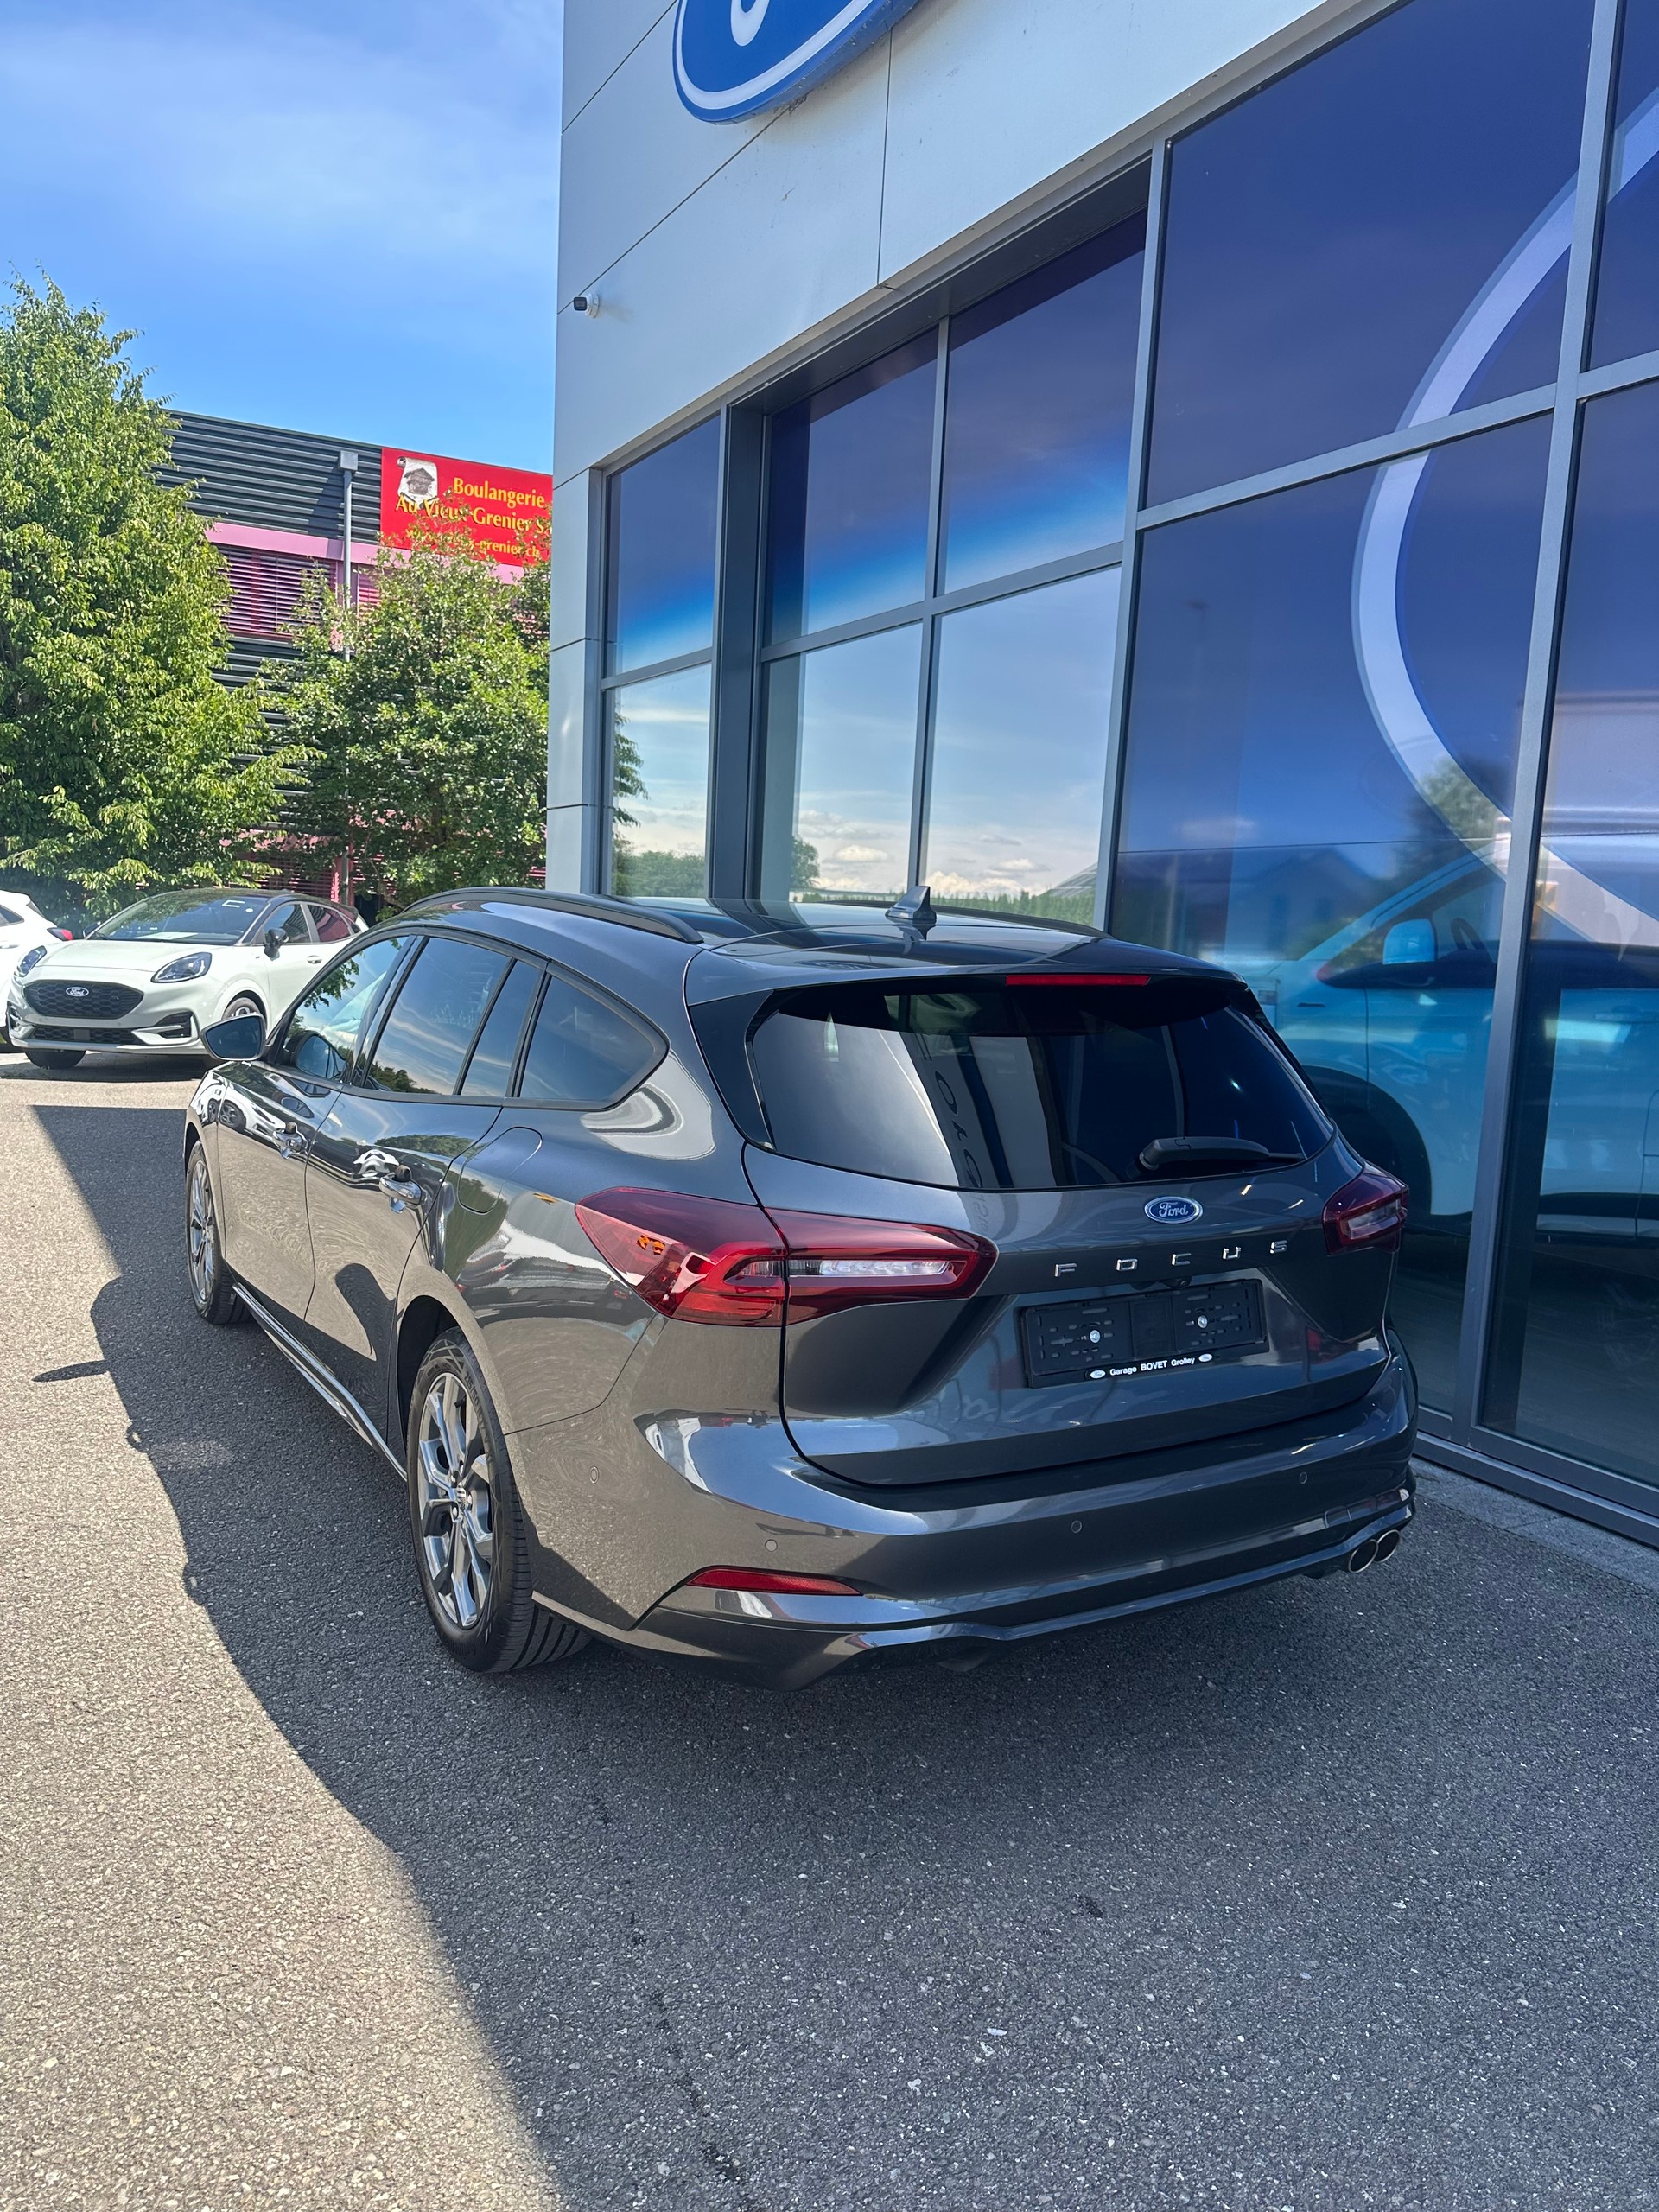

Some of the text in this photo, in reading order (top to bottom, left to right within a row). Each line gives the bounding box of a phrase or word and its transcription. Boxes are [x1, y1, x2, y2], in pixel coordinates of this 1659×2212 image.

[454, 477, 545, 508] Boulangerie
[396, 495, 417, 514] Au
[473, 506, 531, 531] Grenier
[1054, 1240, 1288, 1277] FOCUS
[1109, 1366, 1137, 1376] Garage
[1141, 1360, 1167, 1371] BOVET
[1171, 1357, 1195, 1367] Grolley
